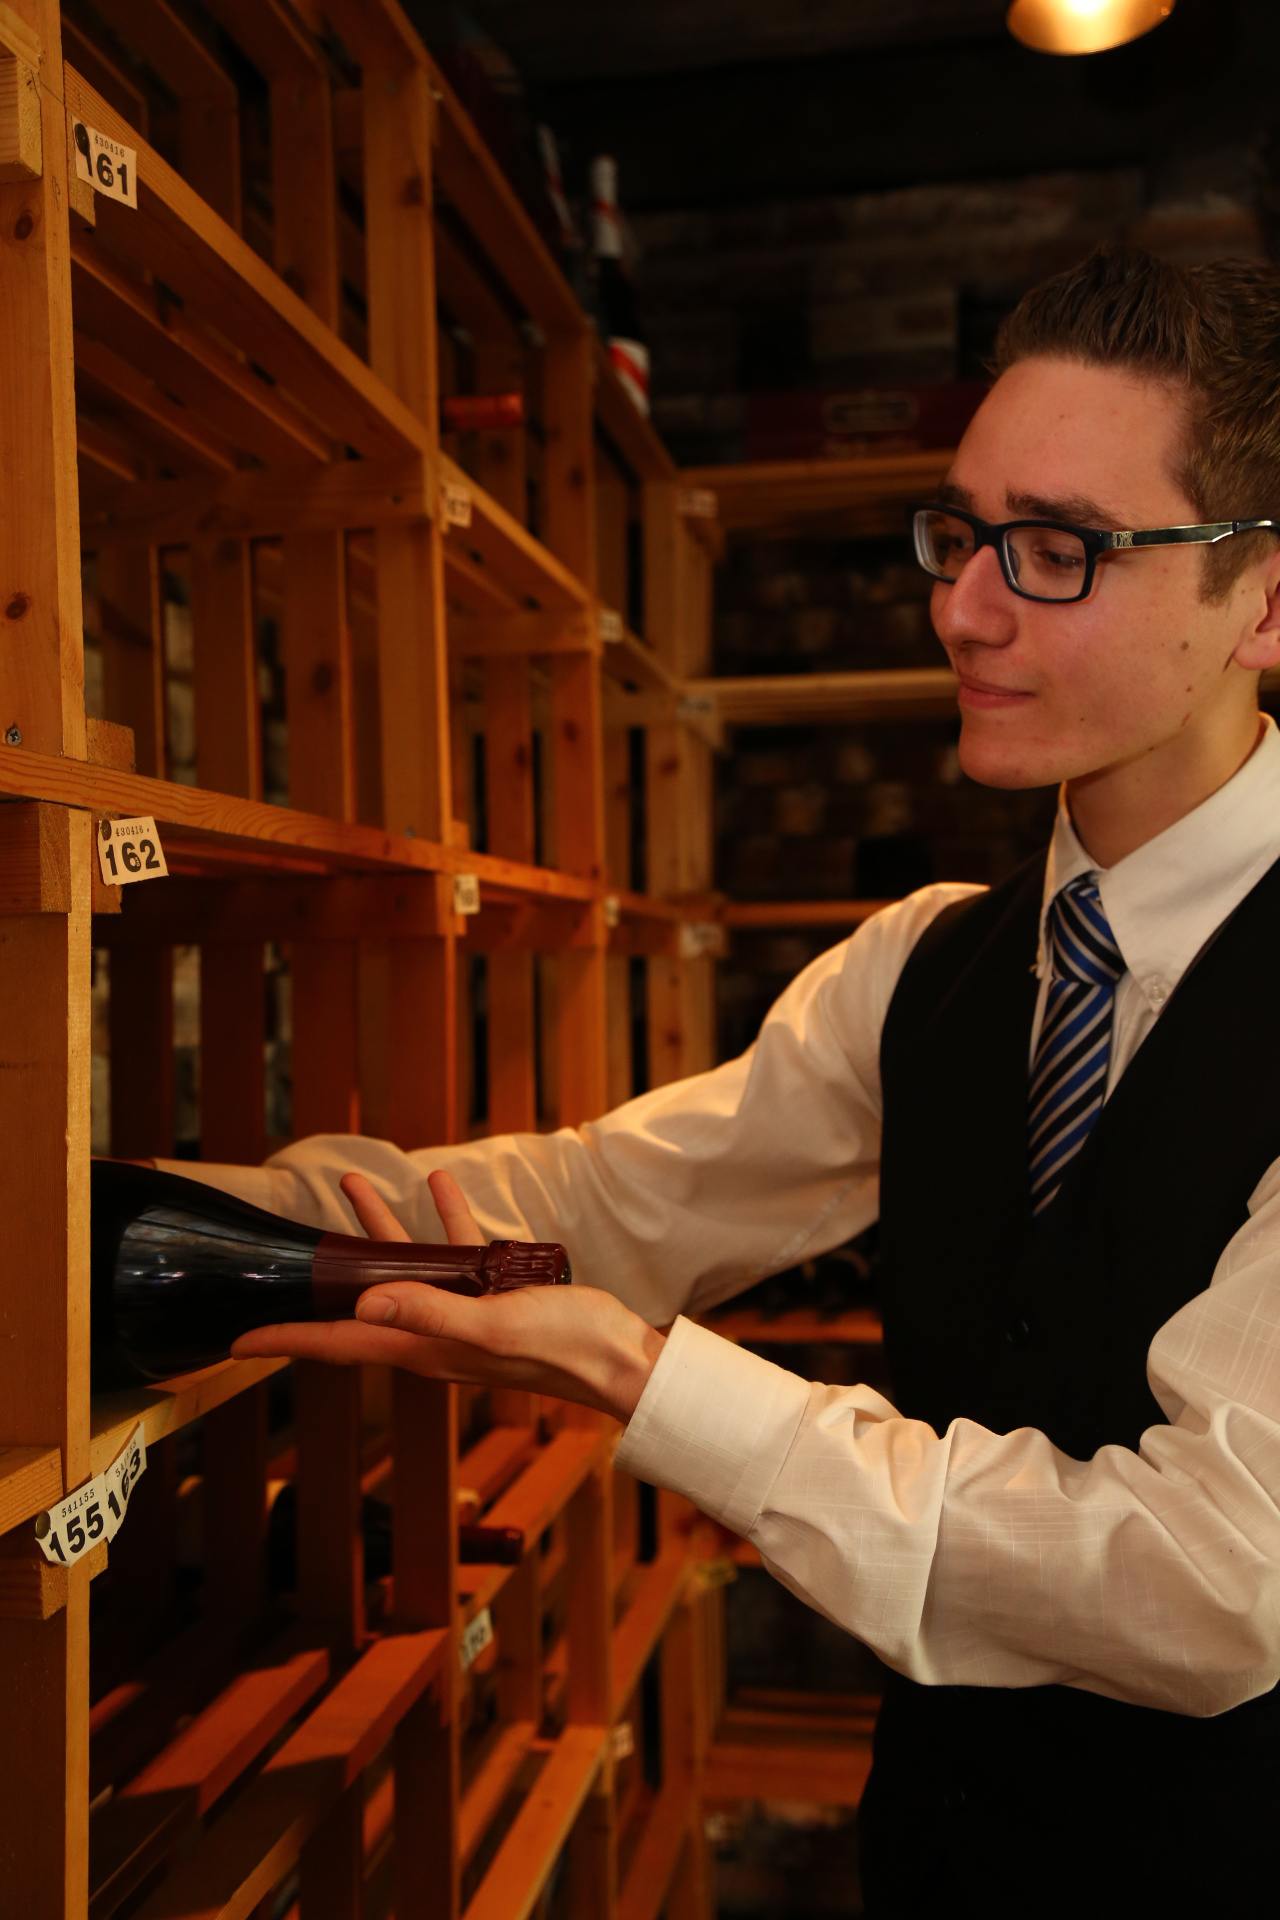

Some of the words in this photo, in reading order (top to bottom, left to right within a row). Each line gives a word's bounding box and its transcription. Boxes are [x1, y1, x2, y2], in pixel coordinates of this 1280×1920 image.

[105, 839, 161, 877] 162
[61, 1488, 96, 1518] 541155
[107, 1448, 141, 1521] 163
[49, 1501, 104, 1562] 155
